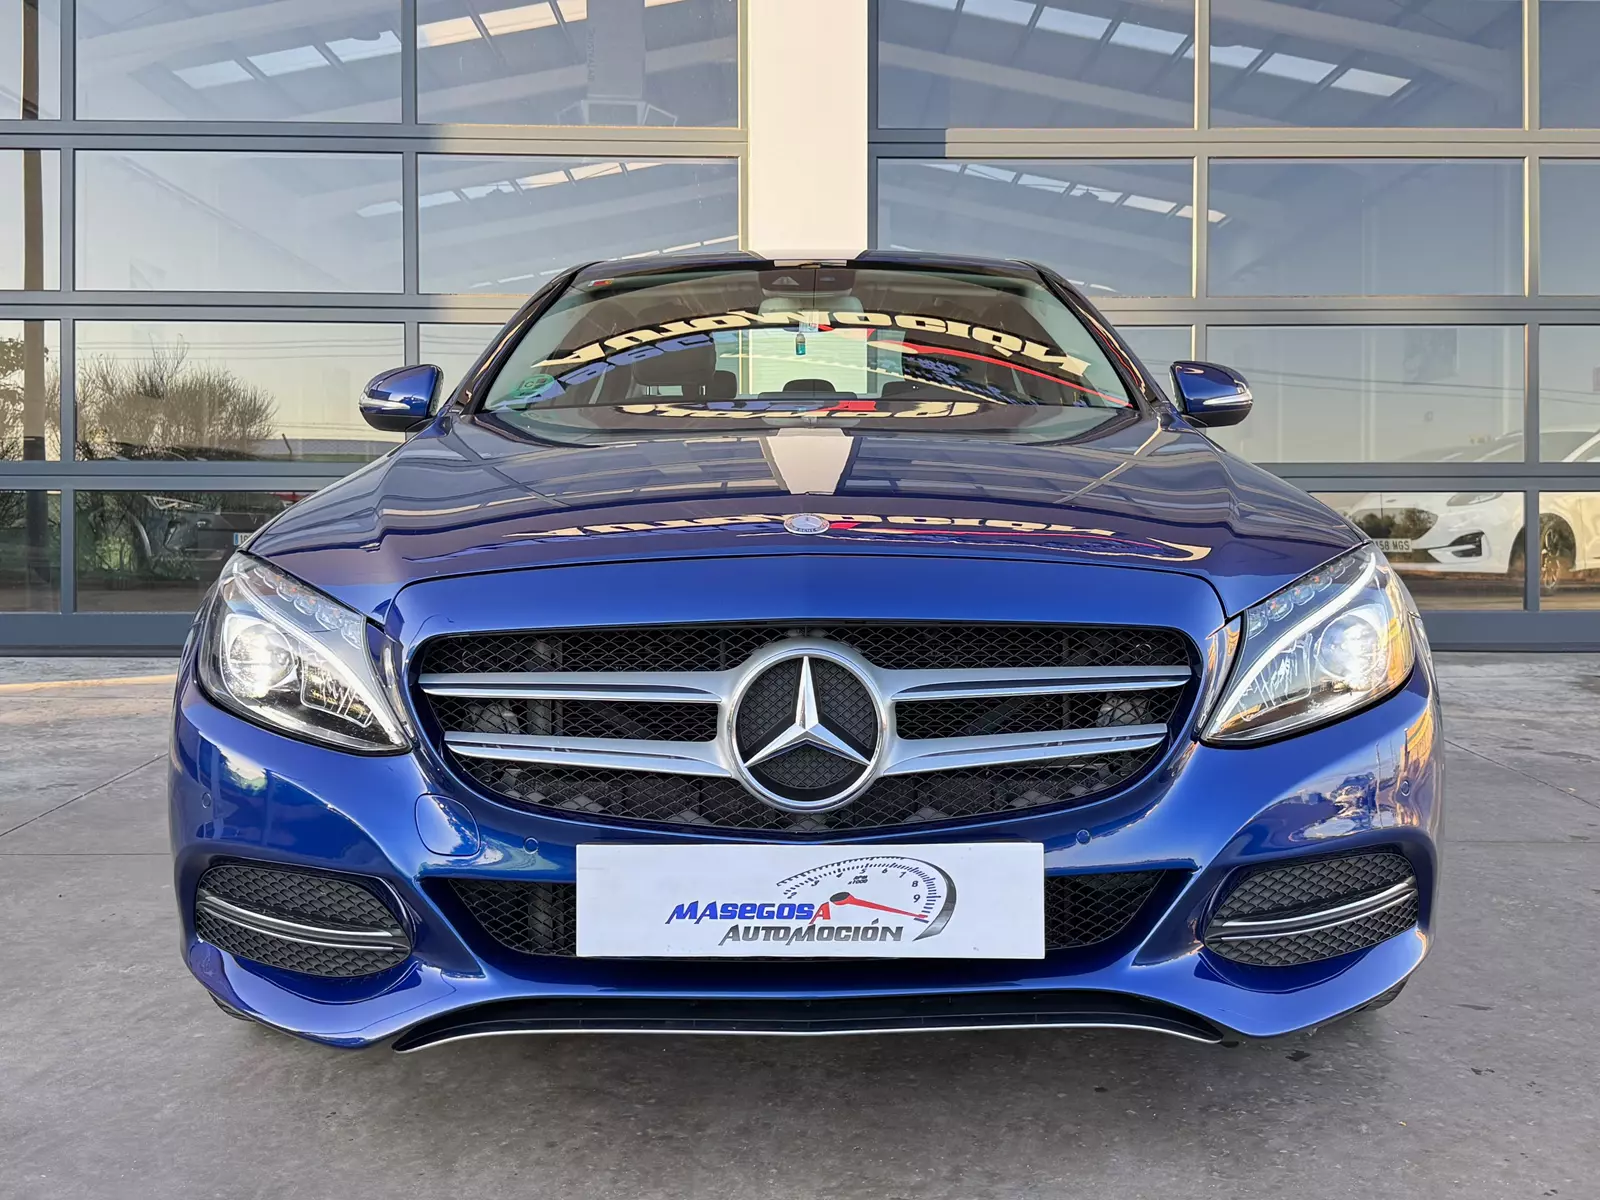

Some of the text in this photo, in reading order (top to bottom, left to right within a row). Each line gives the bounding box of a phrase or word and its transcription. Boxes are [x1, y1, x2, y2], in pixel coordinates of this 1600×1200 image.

[1392, 540, 1410, 550] MGS
[911, 880, 919, 888] 8
[913, 894, 921, 903] 9
[665, 900, 831, 924] MASEGOSA
[718, 918, 904, 946] AUTOMOCIÓN
